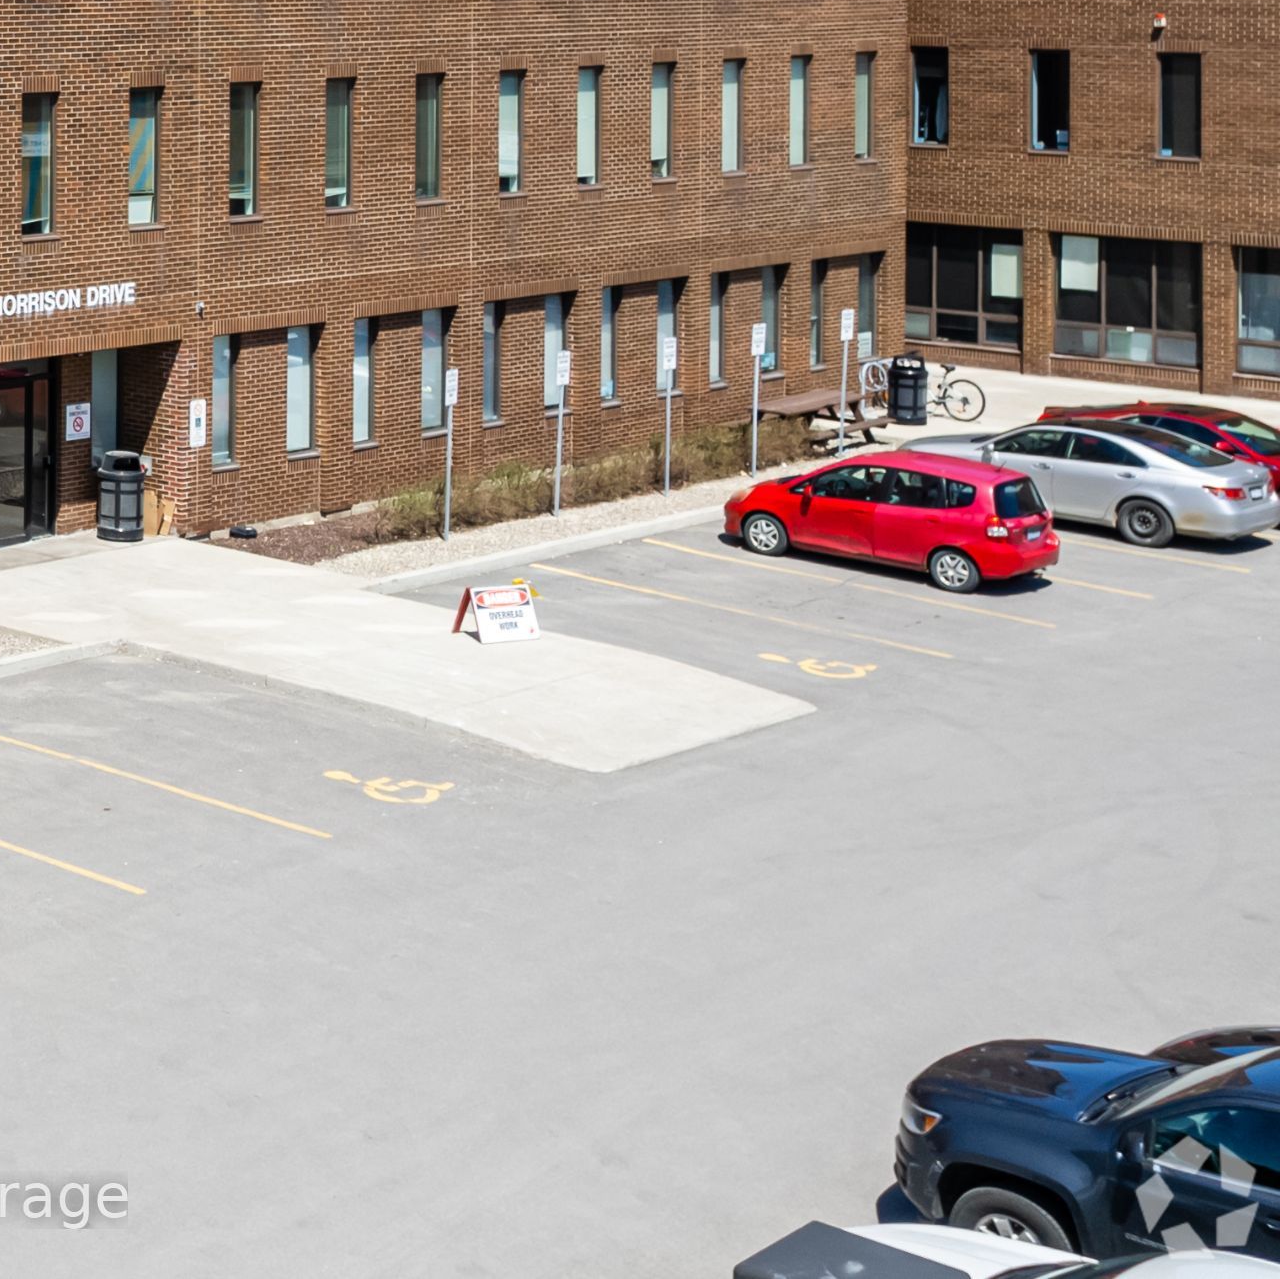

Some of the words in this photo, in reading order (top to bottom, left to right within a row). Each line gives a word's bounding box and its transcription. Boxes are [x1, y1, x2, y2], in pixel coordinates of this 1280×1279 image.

[86, 281, 137, 307] DRIVE
[488, 609, 524, 621] OVERHEAD
[499, 621, 519, 630] WORK
